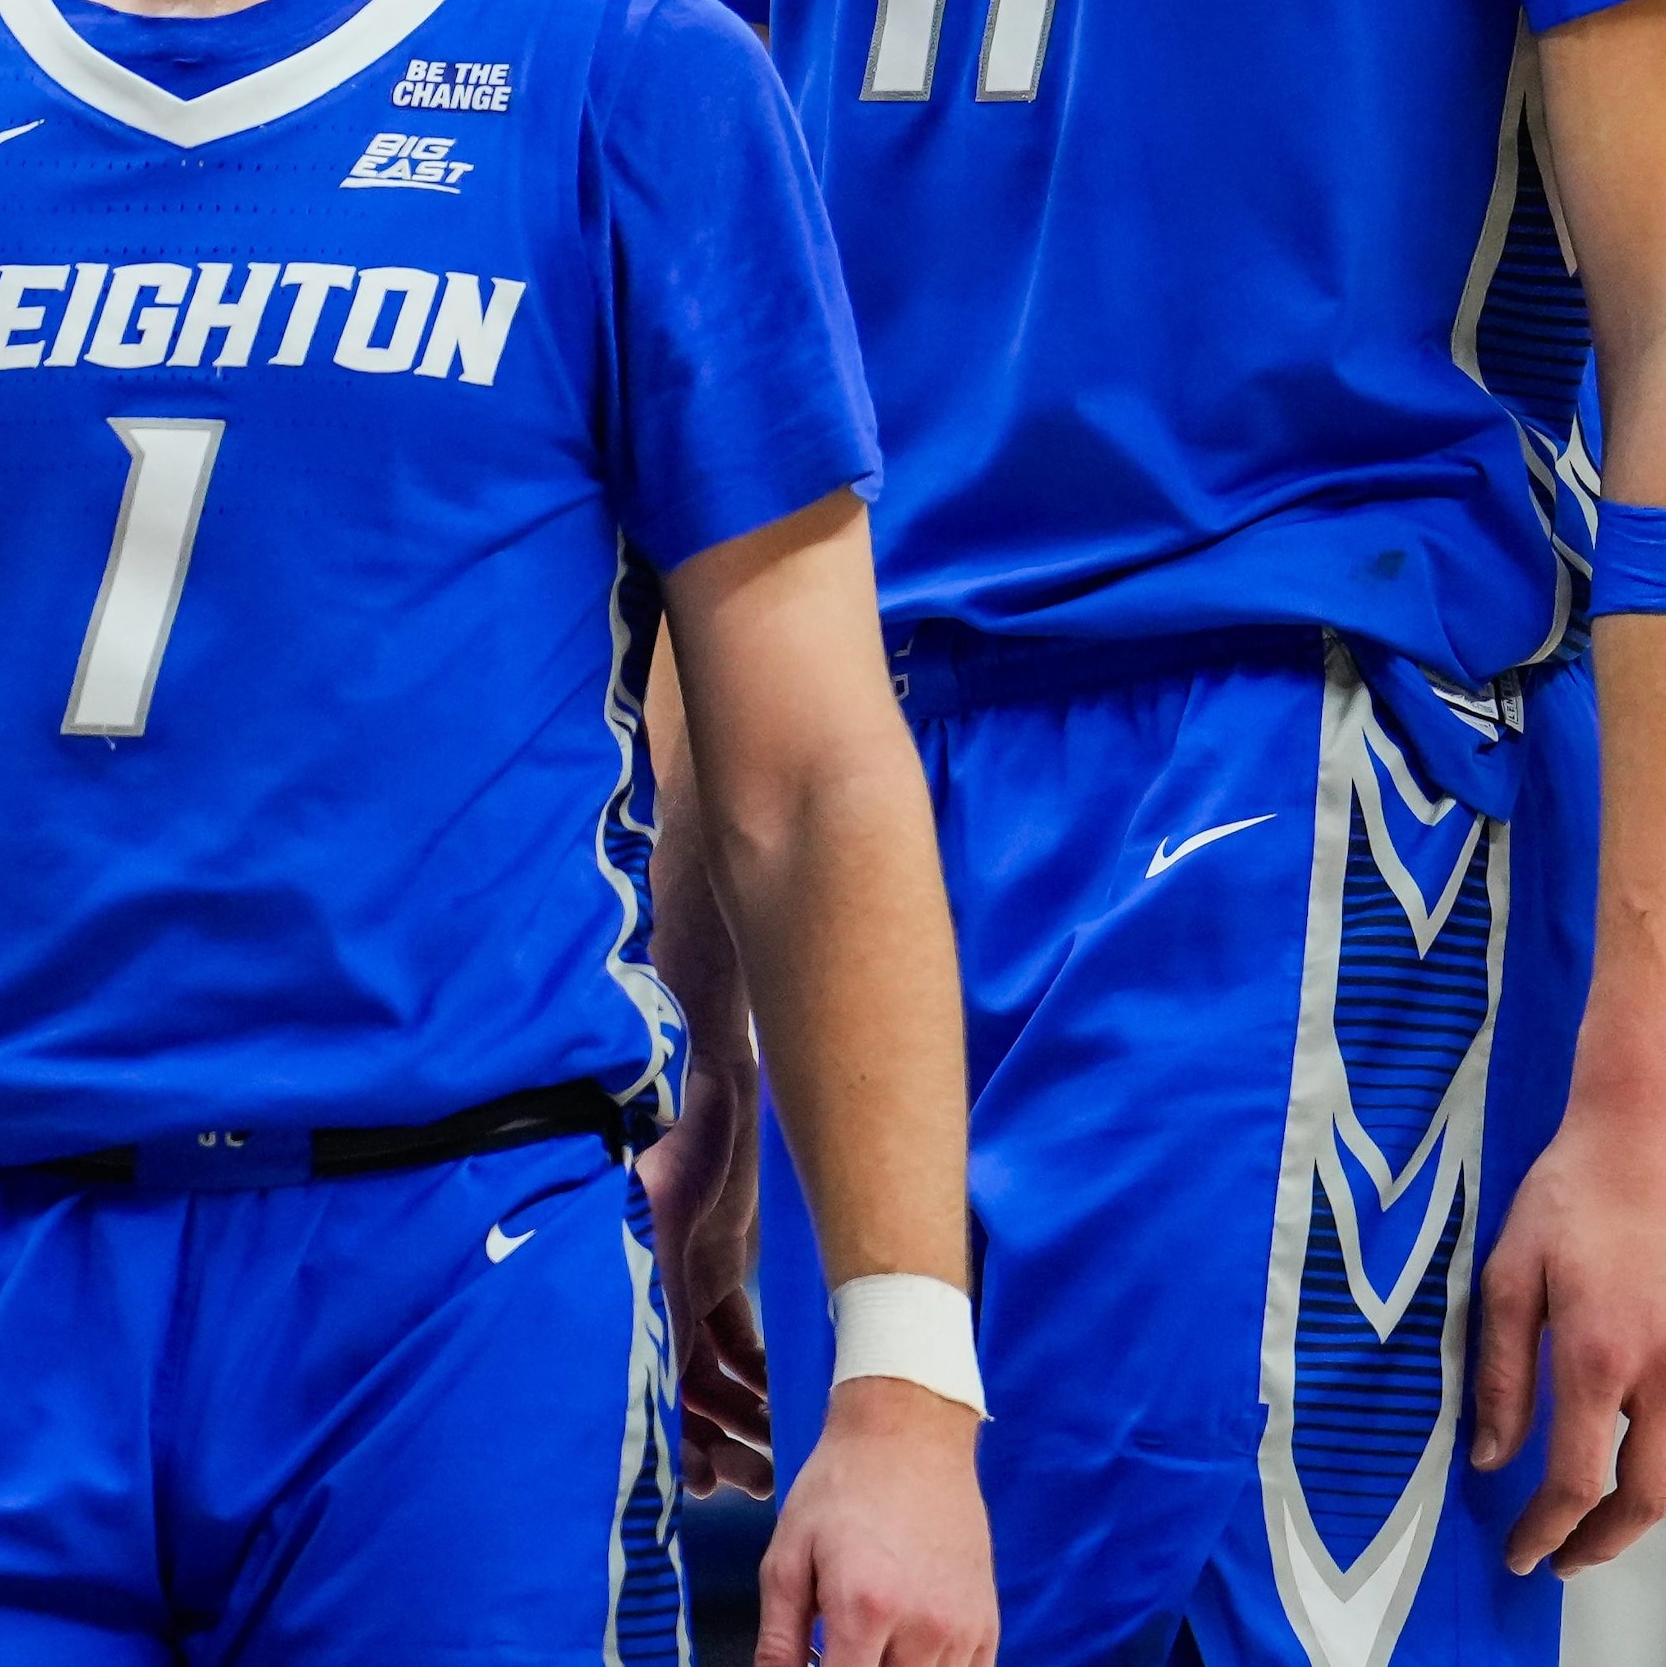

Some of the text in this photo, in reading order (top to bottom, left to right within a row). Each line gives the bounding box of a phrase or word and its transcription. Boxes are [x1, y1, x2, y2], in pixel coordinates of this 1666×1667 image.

[405, 59, 510, 85] BE THE
[392, 80, 512, 111] CHANGE
[365, 133, 456, 160] BIG
[349, 154, 474, 183] EAST
[61, 417, 225, 736] 1
